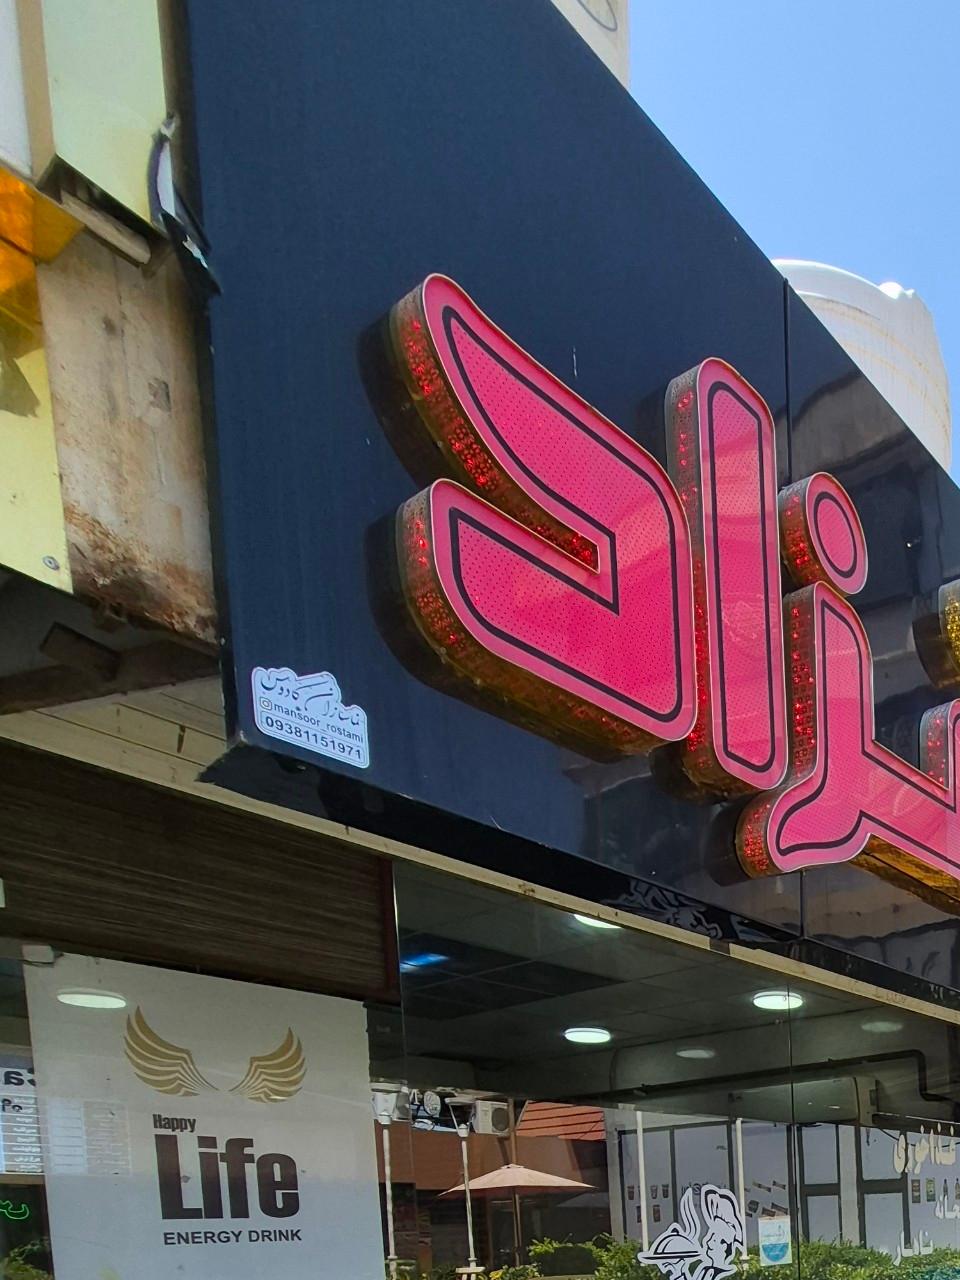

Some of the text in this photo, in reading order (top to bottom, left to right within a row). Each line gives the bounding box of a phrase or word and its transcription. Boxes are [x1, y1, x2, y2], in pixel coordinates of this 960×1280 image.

[265, 715, 362, 760] 09381151971
[273, 702, 364, 743] mansoor_rostami
[152, 1113, 196, 1133] Happy
[154, 1133, 300, 1220] Life
[163, 1228, 302, 1246] ENERGY DRINK
